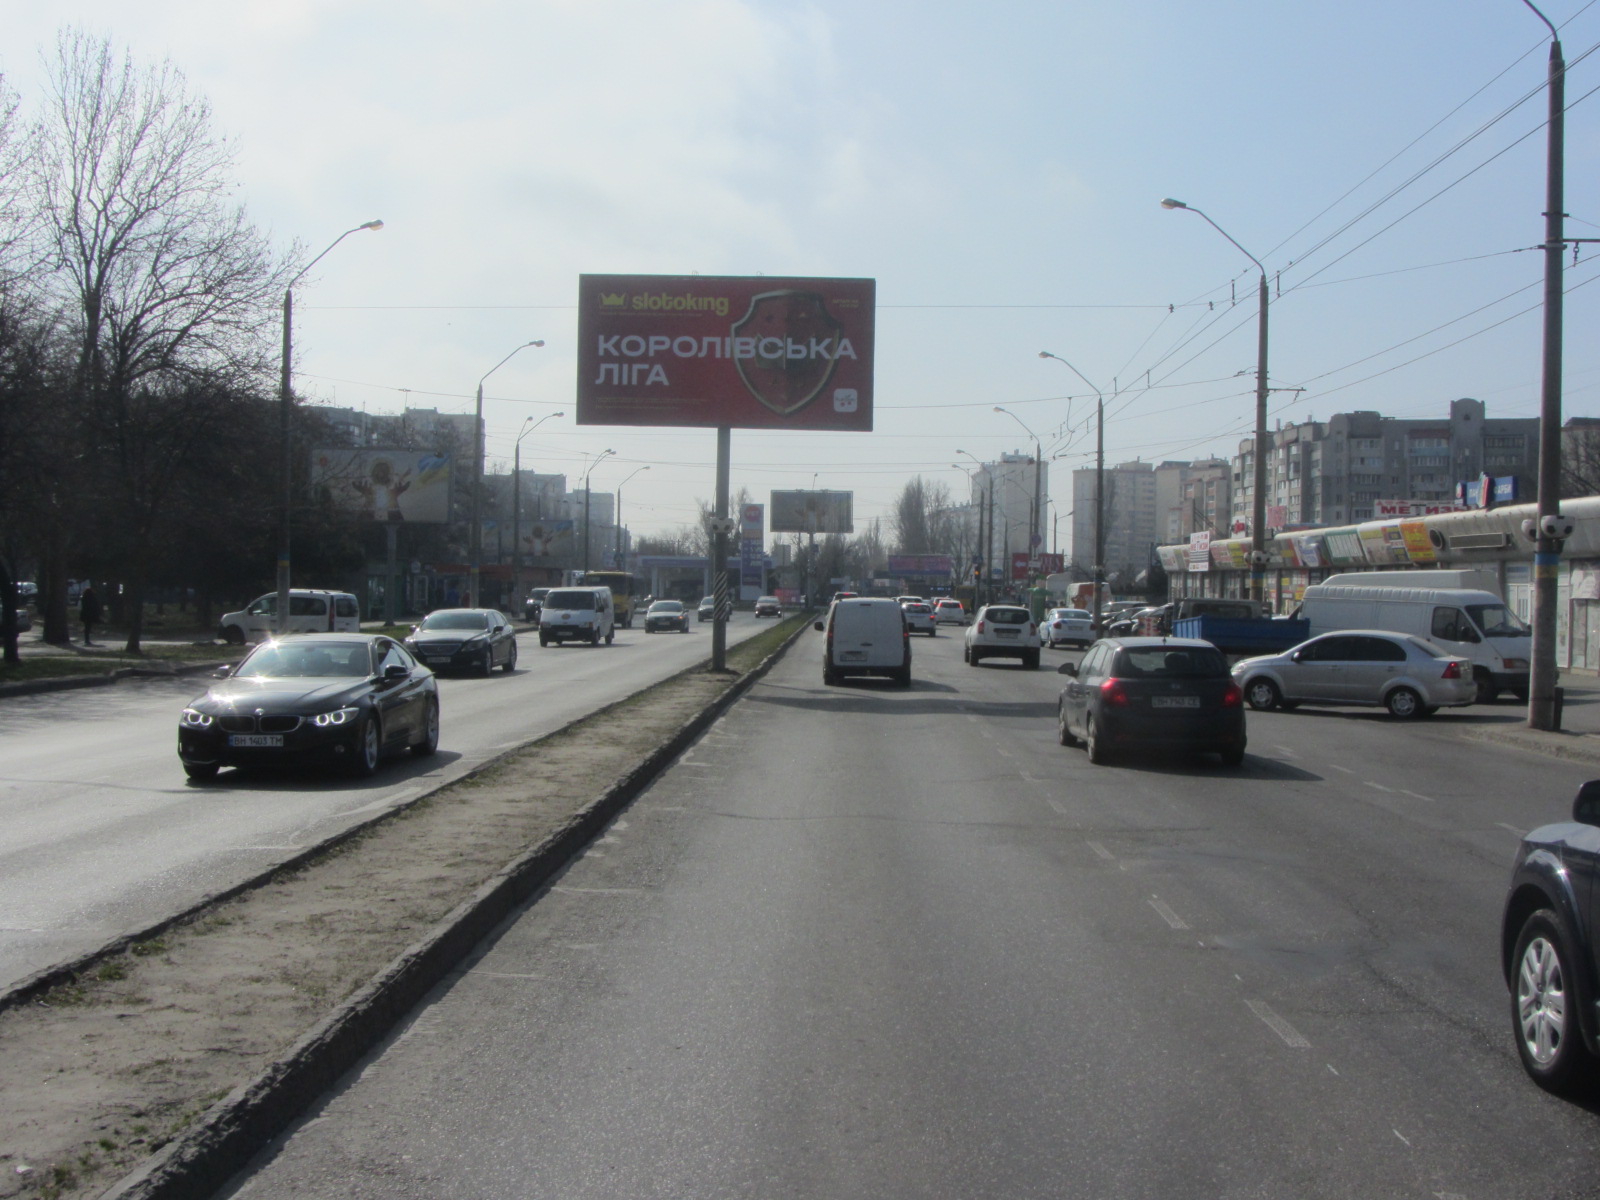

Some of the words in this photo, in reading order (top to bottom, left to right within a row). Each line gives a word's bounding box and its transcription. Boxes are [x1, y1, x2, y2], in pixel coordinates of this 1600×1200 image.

[632, 292, 729, 316] slotoking
[598, 335, 857, 360] КОРОЛІВСЬКА
[595, 363, 669, 386] ЛІГА
[234, 736, 246, 745] BH
[270, 736, 282, 745] TM
